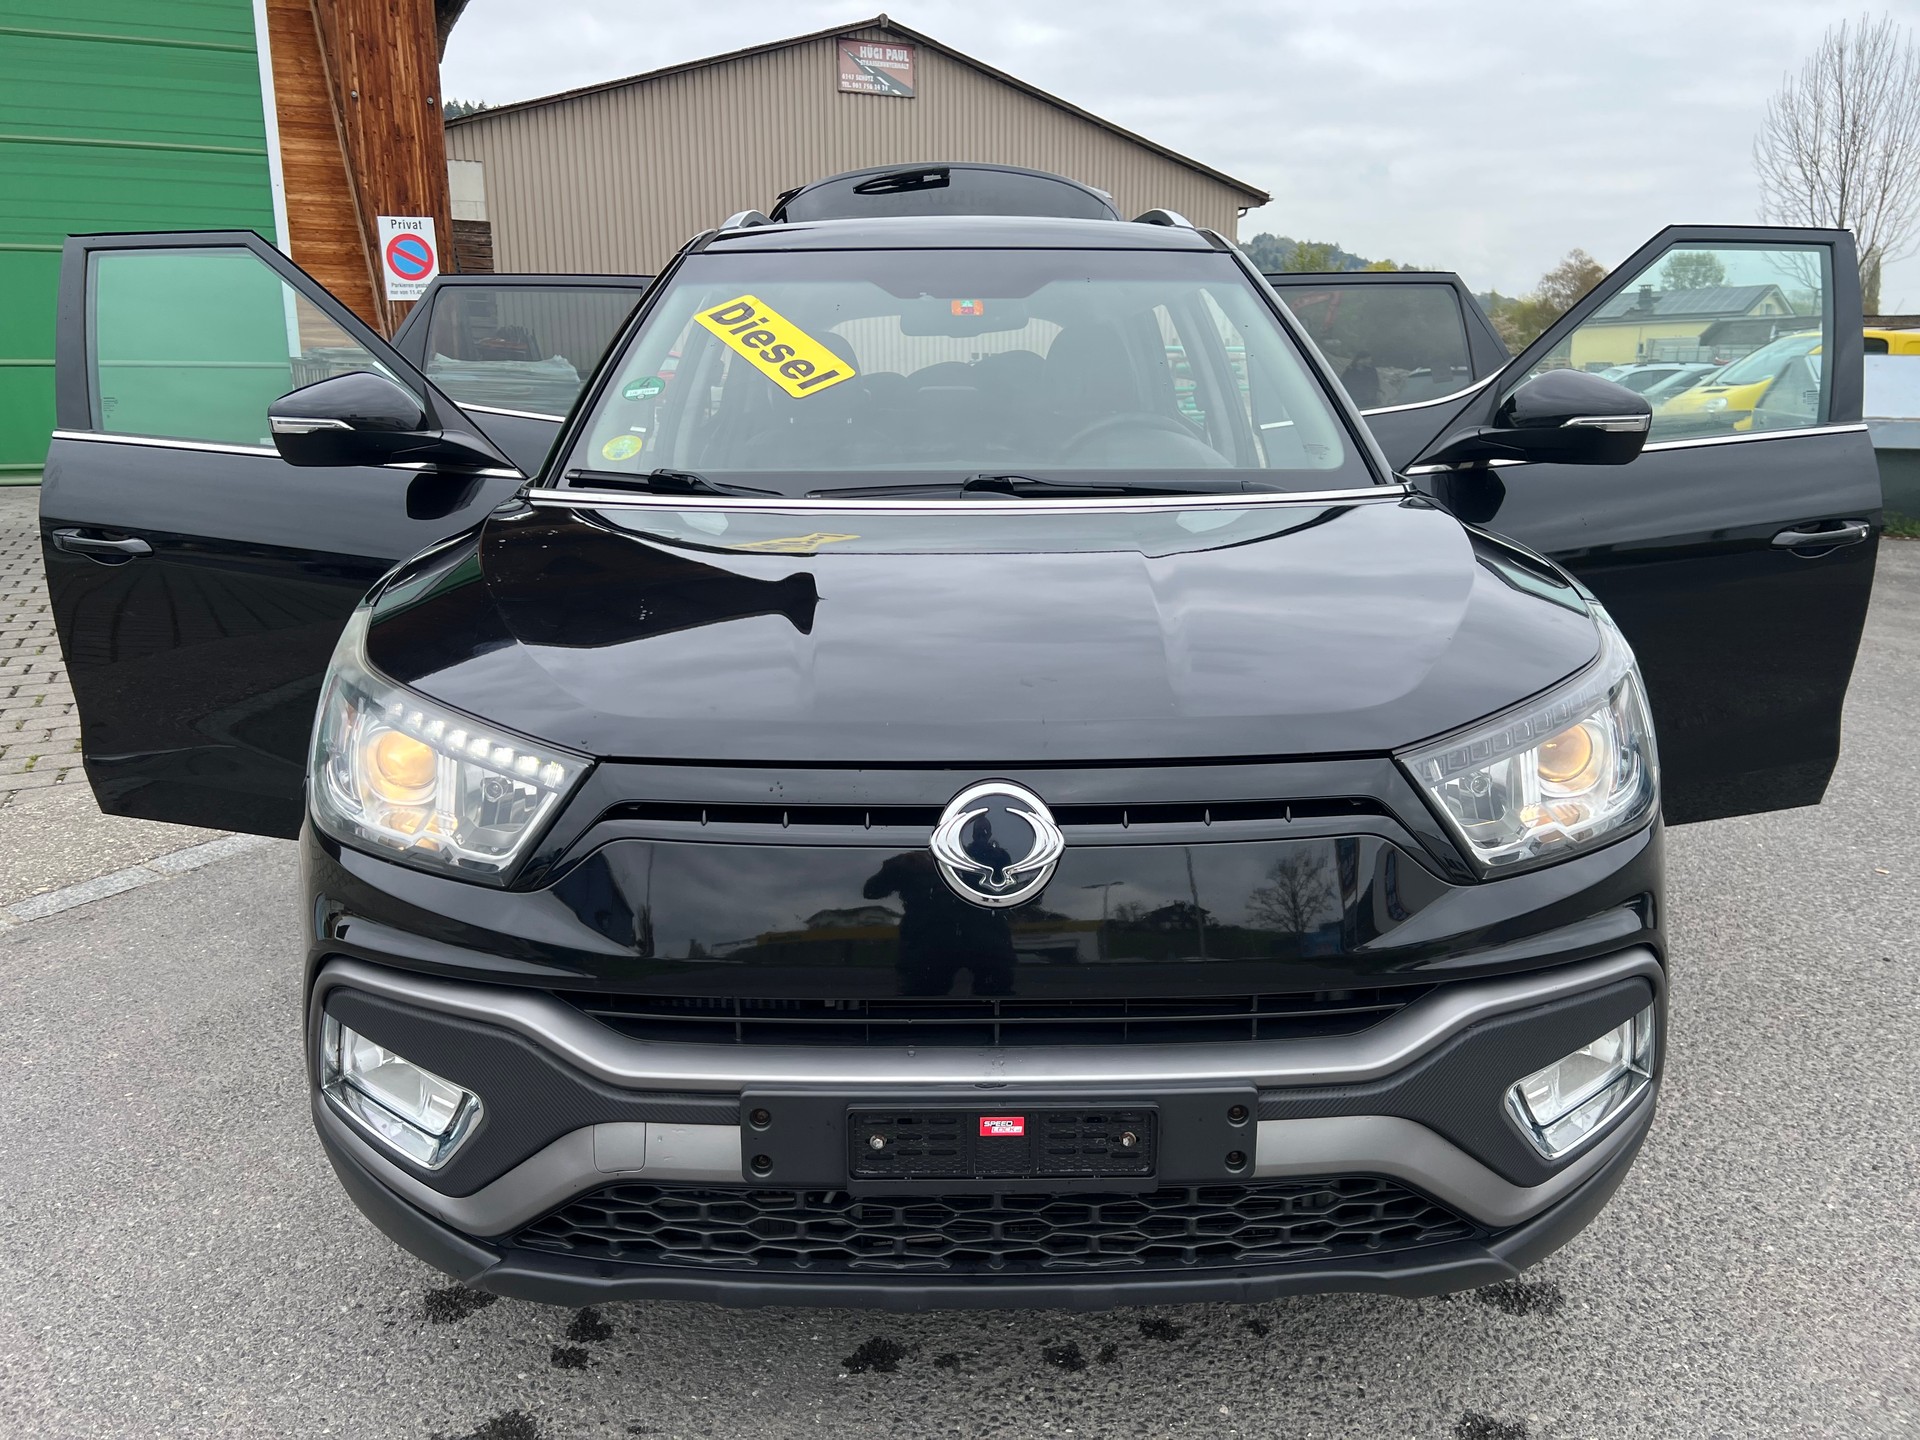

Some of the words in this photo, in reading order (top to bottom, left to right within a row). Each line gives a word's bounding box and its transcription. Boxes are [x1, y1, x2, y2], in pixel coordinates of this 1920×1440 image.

[859, 44, 883, 60] HÜGI
[886, 48, 910, 62] PAUL
[391, 219, 422, 230] Privat
[707, 301, 841, 390] Diesel
